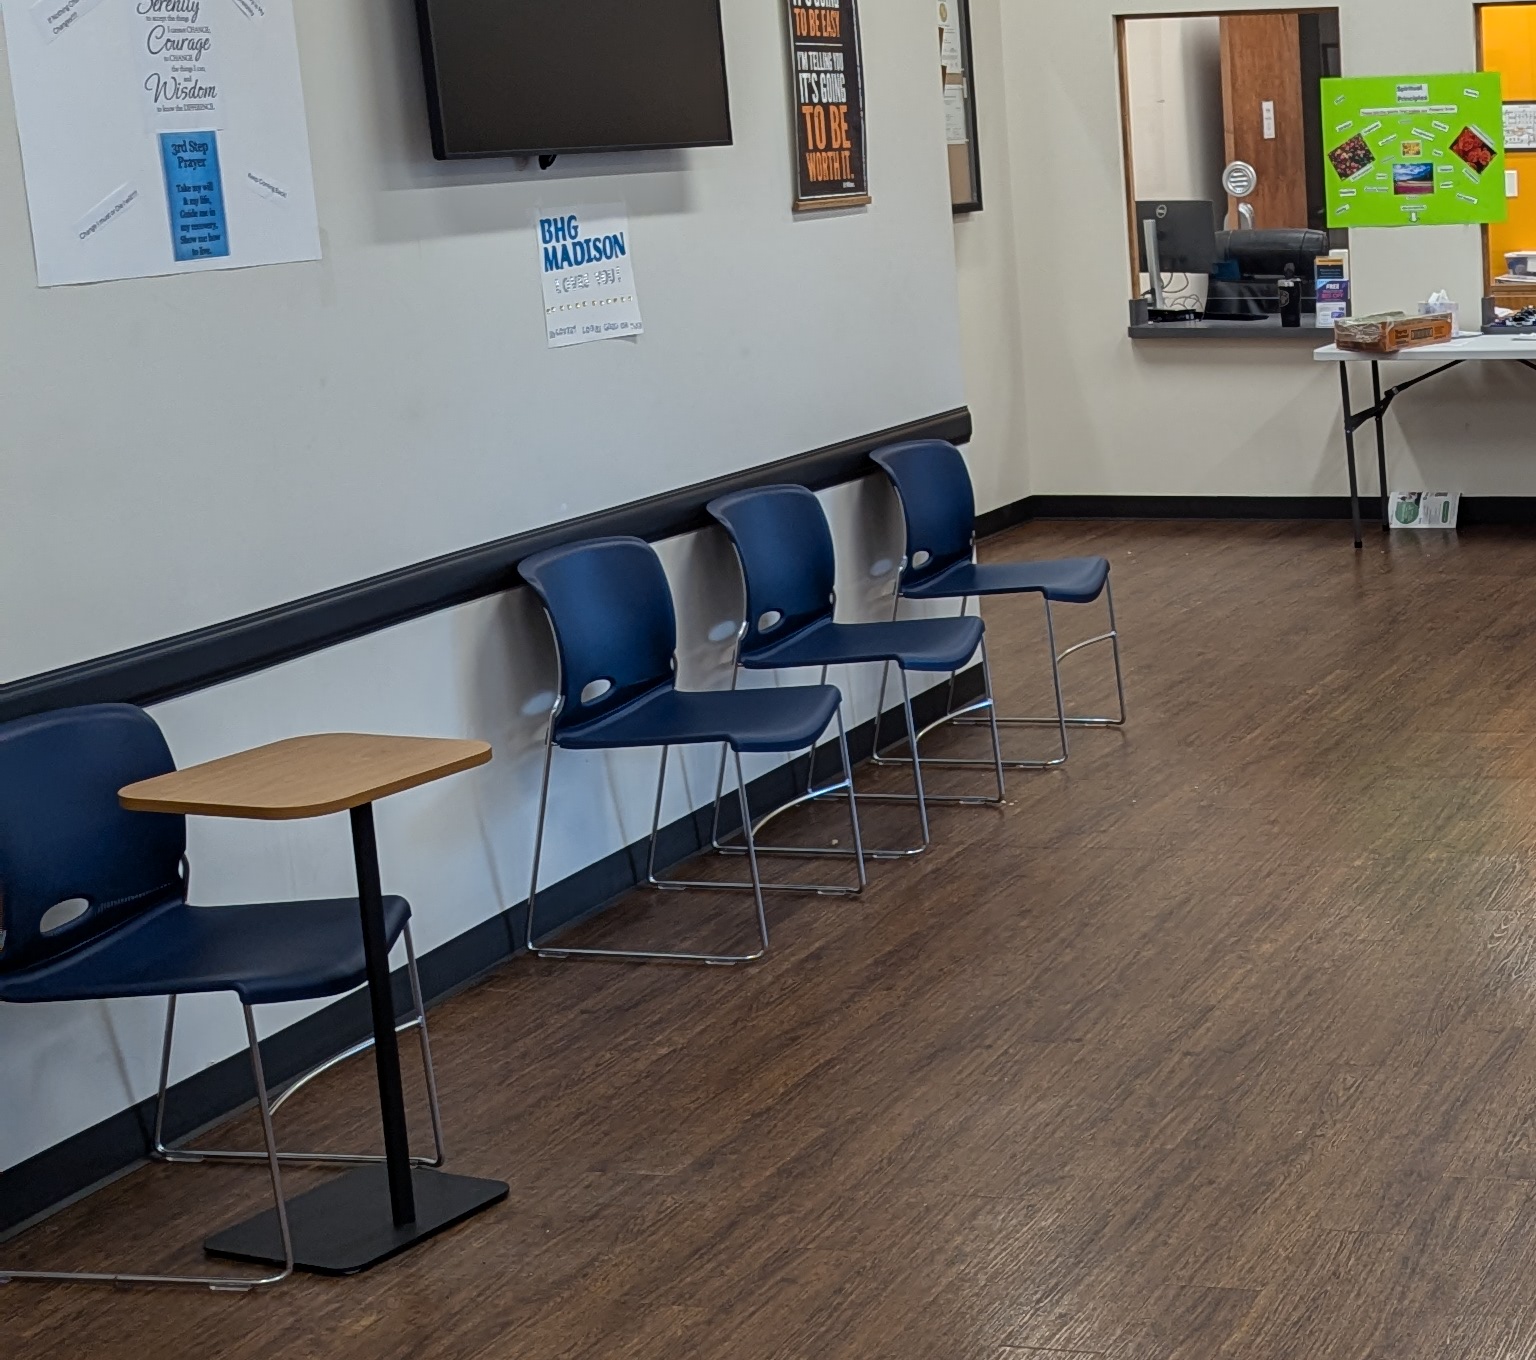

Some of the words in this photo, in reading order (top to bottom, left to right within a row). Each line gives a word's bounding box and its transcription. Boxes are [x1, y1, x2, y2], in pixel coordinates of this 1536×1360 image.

[793, 8, 808, 37] TO
[808, 8, 821, 37] BE
[821, 9, 840, 37] EASY
[147, 24, 211, 62] Courage
[808, 51, 832, 71] TELLING
[832, 52, 844, 71] YOU
[144, 72, 218, 103] Wisdom
[798, 72, 819, 104] IT'S
[820, 72, 847, 104] GOING
[801, 104, 827, 150] TO
[829, 104, 851, 149] BE
[171, 140, 187, 156] 3rd
[189, 140, 208, 155] Step
[177, 156, 207, 170] Prayer
[806, 150, 842, 182] WORTH
[841, 150, 855, 180] IT.
[539, 214, 579, 244] BHG
[543, 231, 627, 272] MADISON
